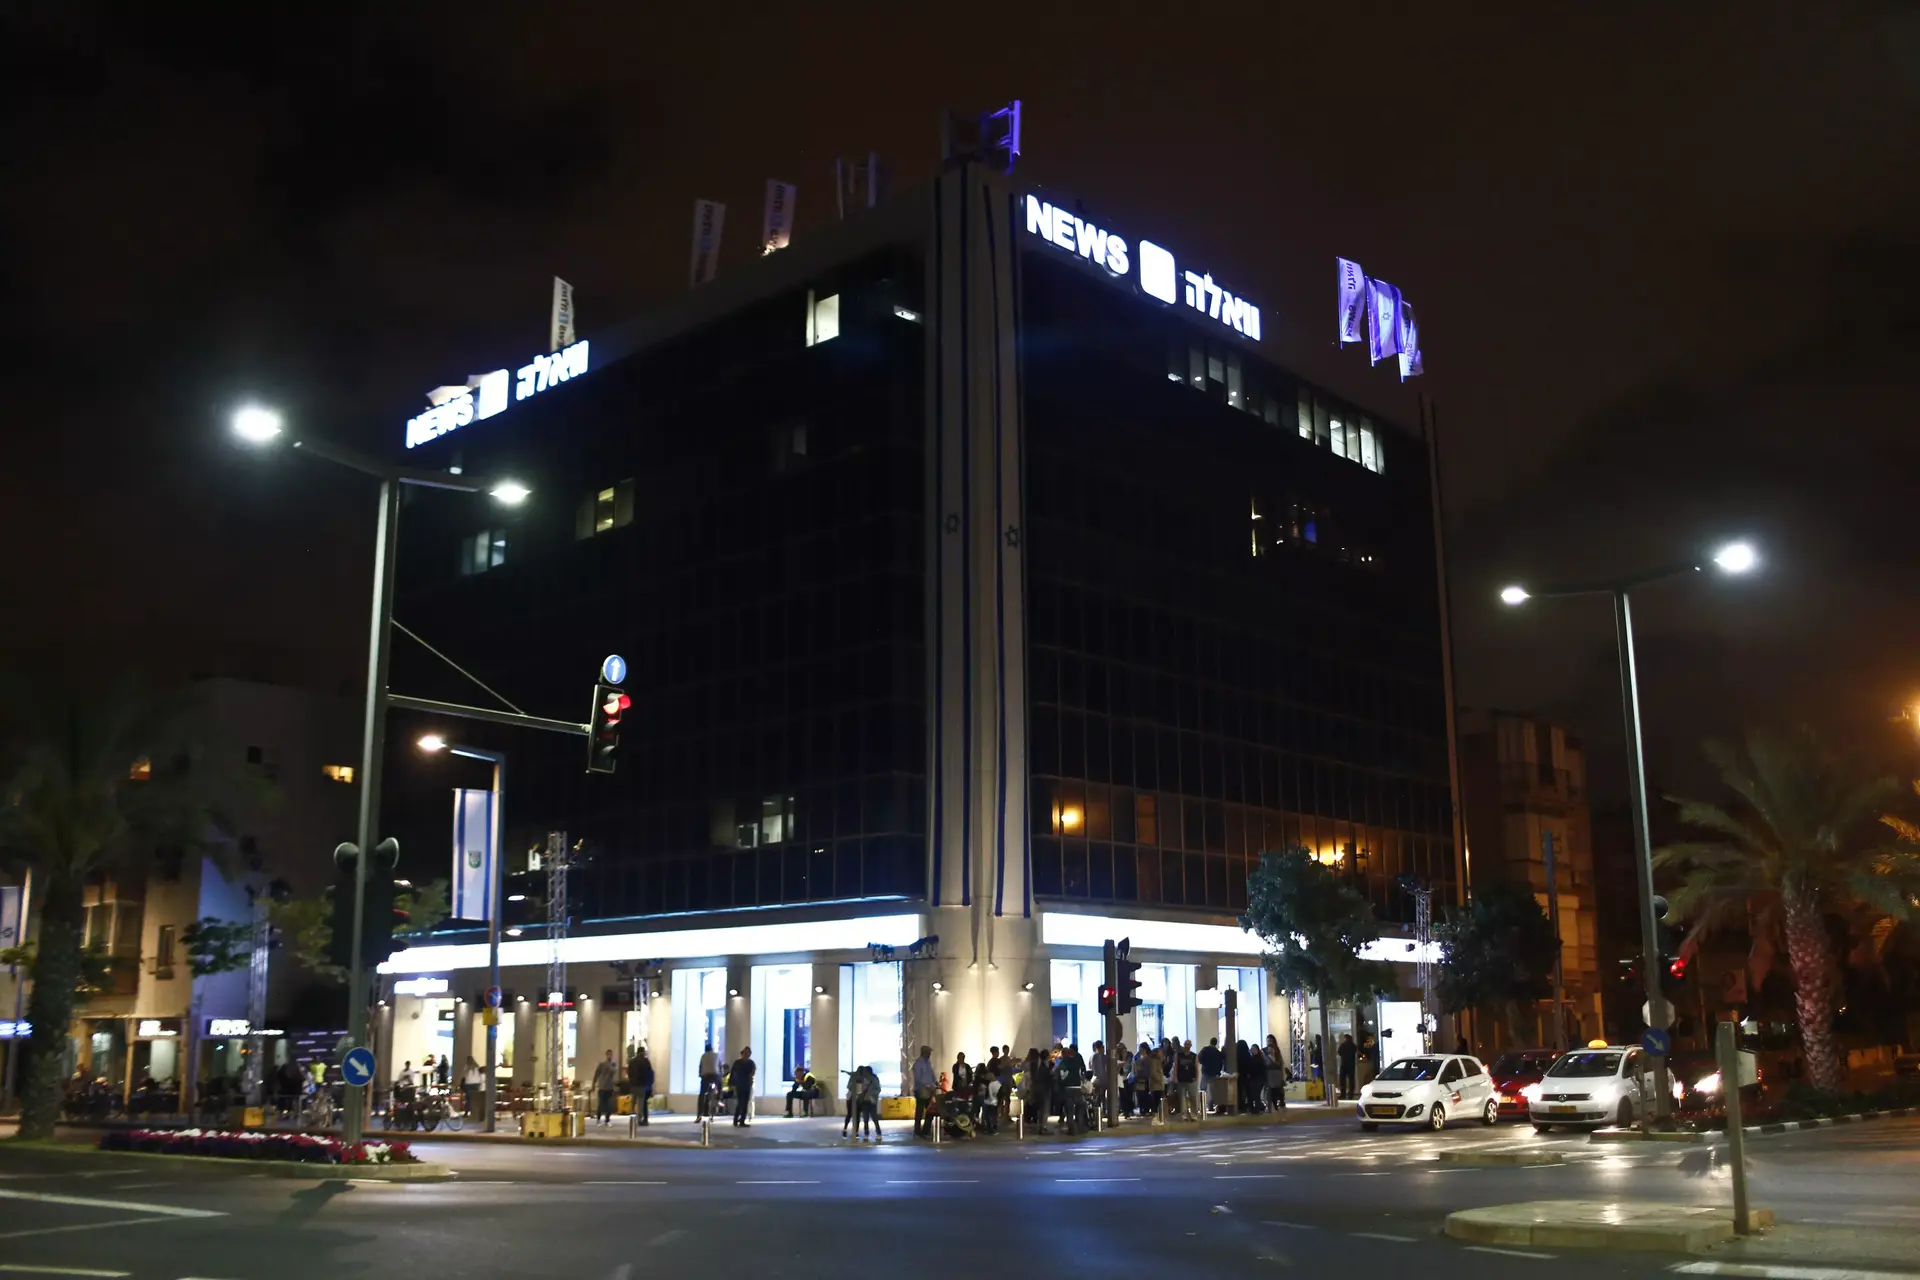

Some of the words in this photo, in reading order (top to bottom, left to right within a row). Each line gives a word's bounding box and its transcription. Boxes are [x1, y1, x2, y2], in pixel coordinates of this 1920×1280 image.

[1026, 194, 1130, 275] NEWS
[1185, 270, 1261, 341] וואלה
[406, 393, 474, 449] NEWS
